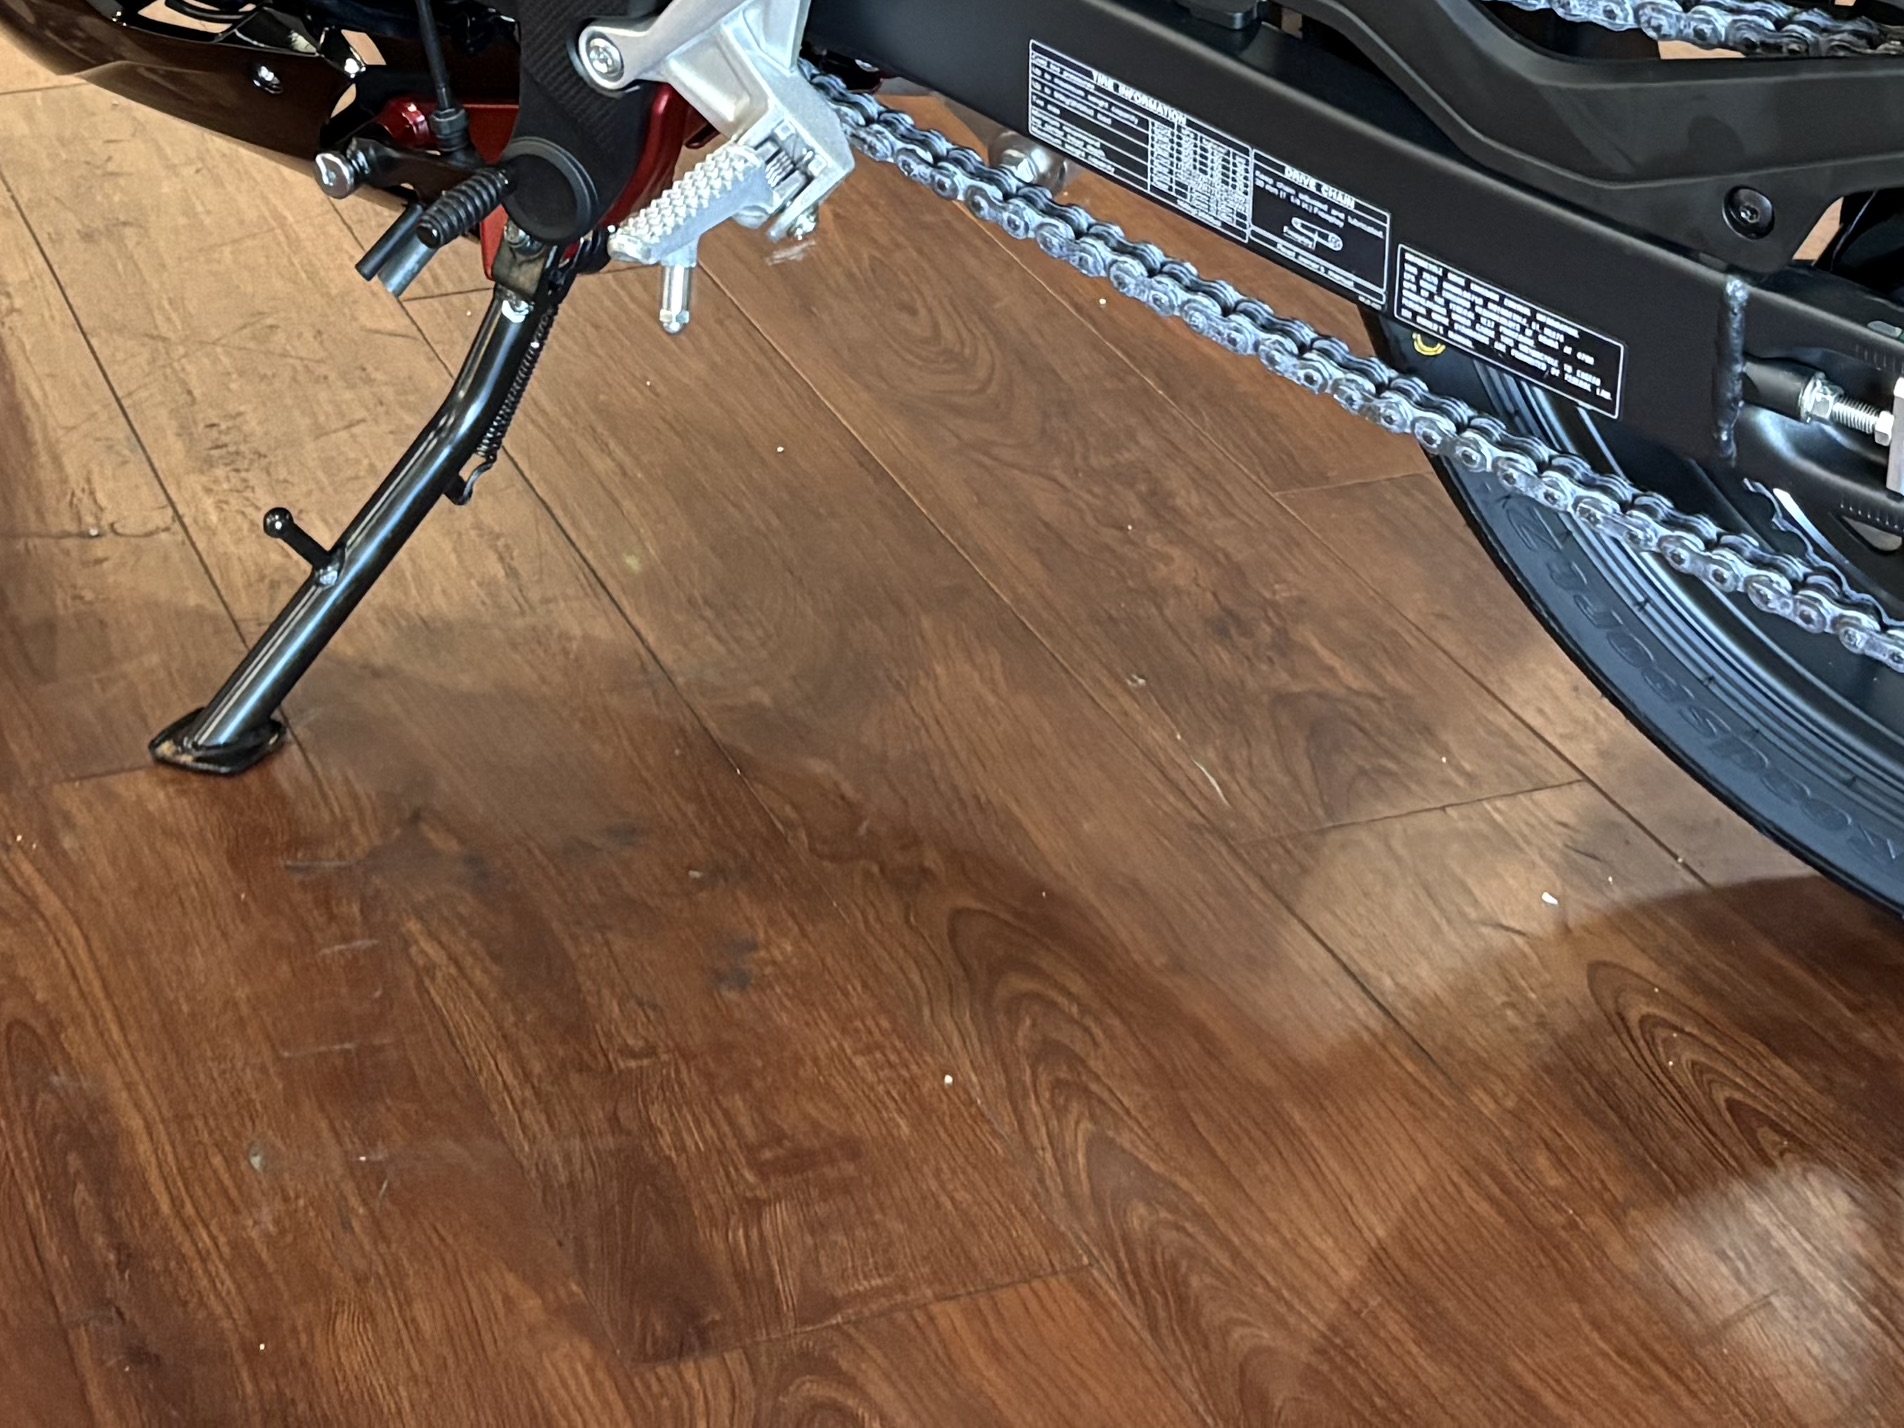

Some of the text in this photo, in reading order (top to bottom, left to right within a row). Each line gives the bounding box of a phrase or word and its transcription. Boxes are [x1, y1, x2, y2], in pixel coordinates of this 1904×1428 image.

[1117, 82, 1187, 126] INFORMATION
[1284, 165, 1355, 210] DRIVE CHAIN
